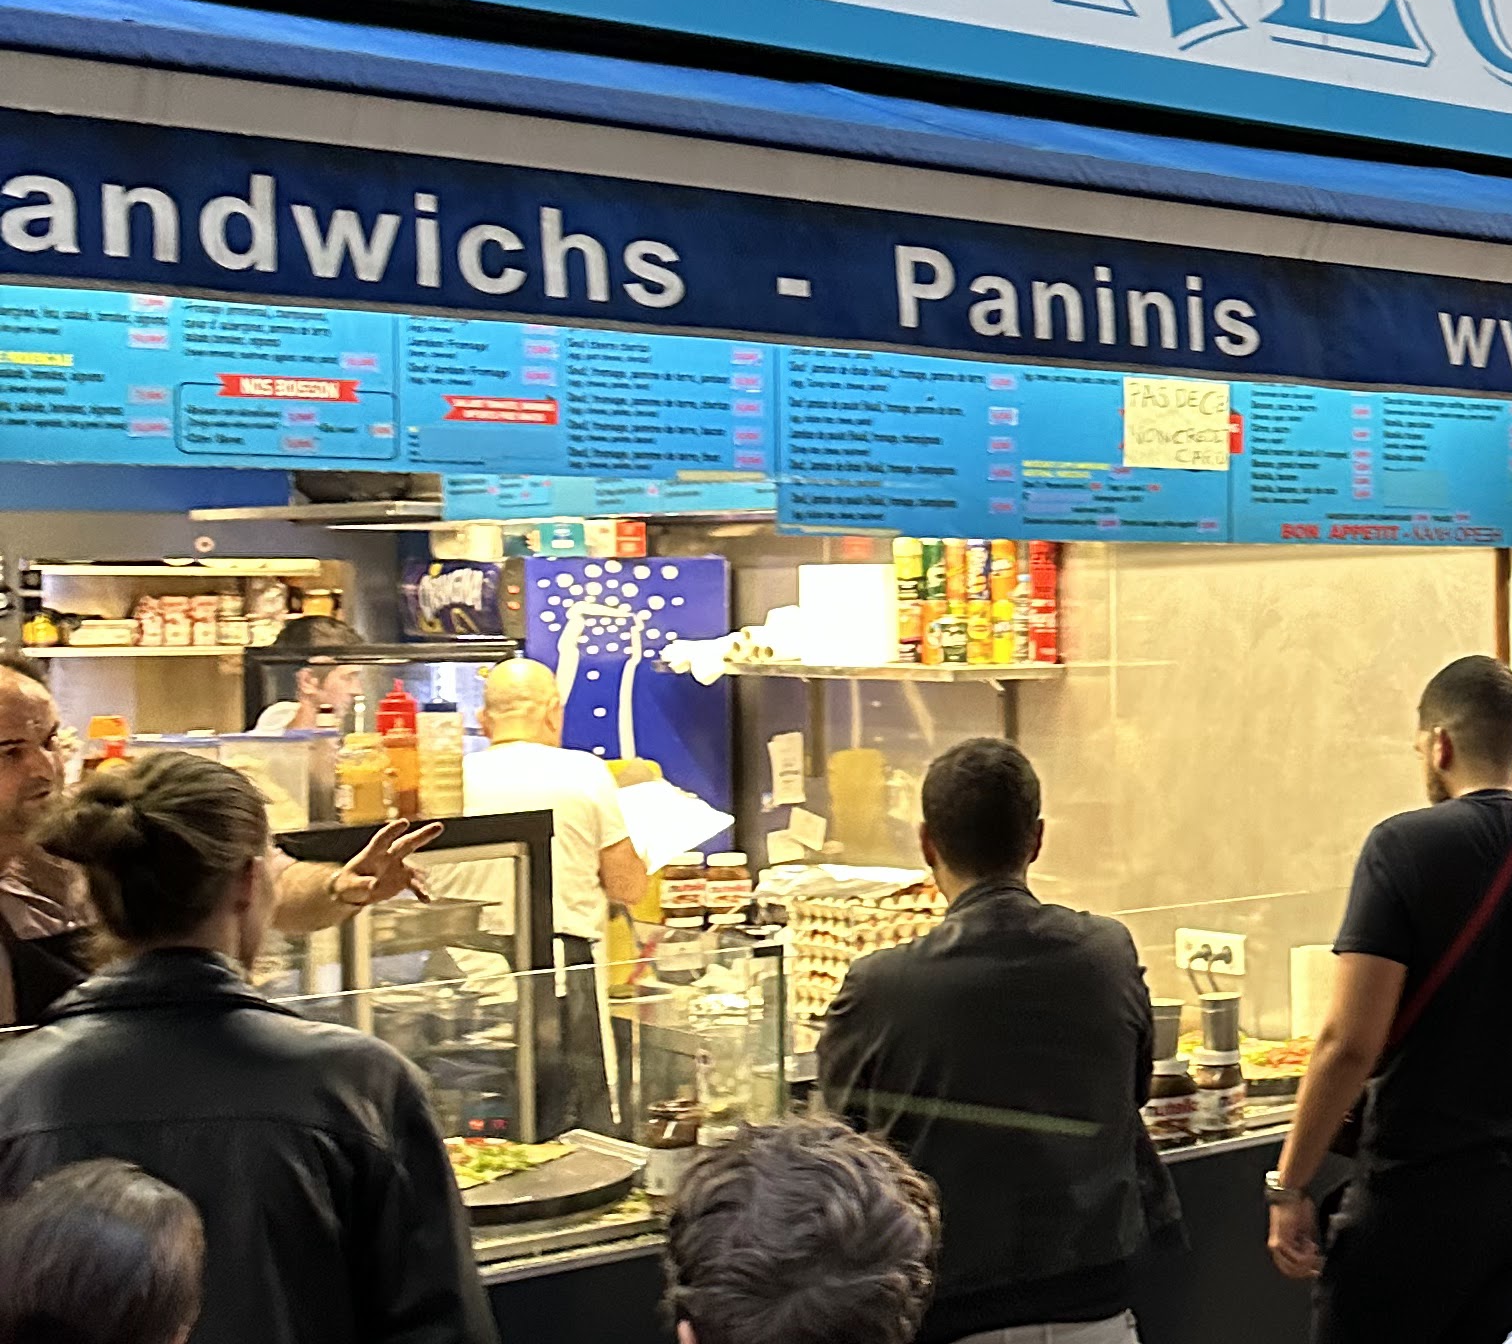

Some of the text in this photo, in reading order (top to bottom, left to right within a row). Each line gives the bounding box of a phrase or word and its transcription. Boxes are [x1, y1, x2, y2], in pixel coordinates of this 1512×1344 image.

[0, 172, 686, 309] andwichs
[894, 243, 1260, 358] Paninis
[1128, 382, 1170, 409] PAS
[1280, 522, 1400, 541] BON APPETIT
